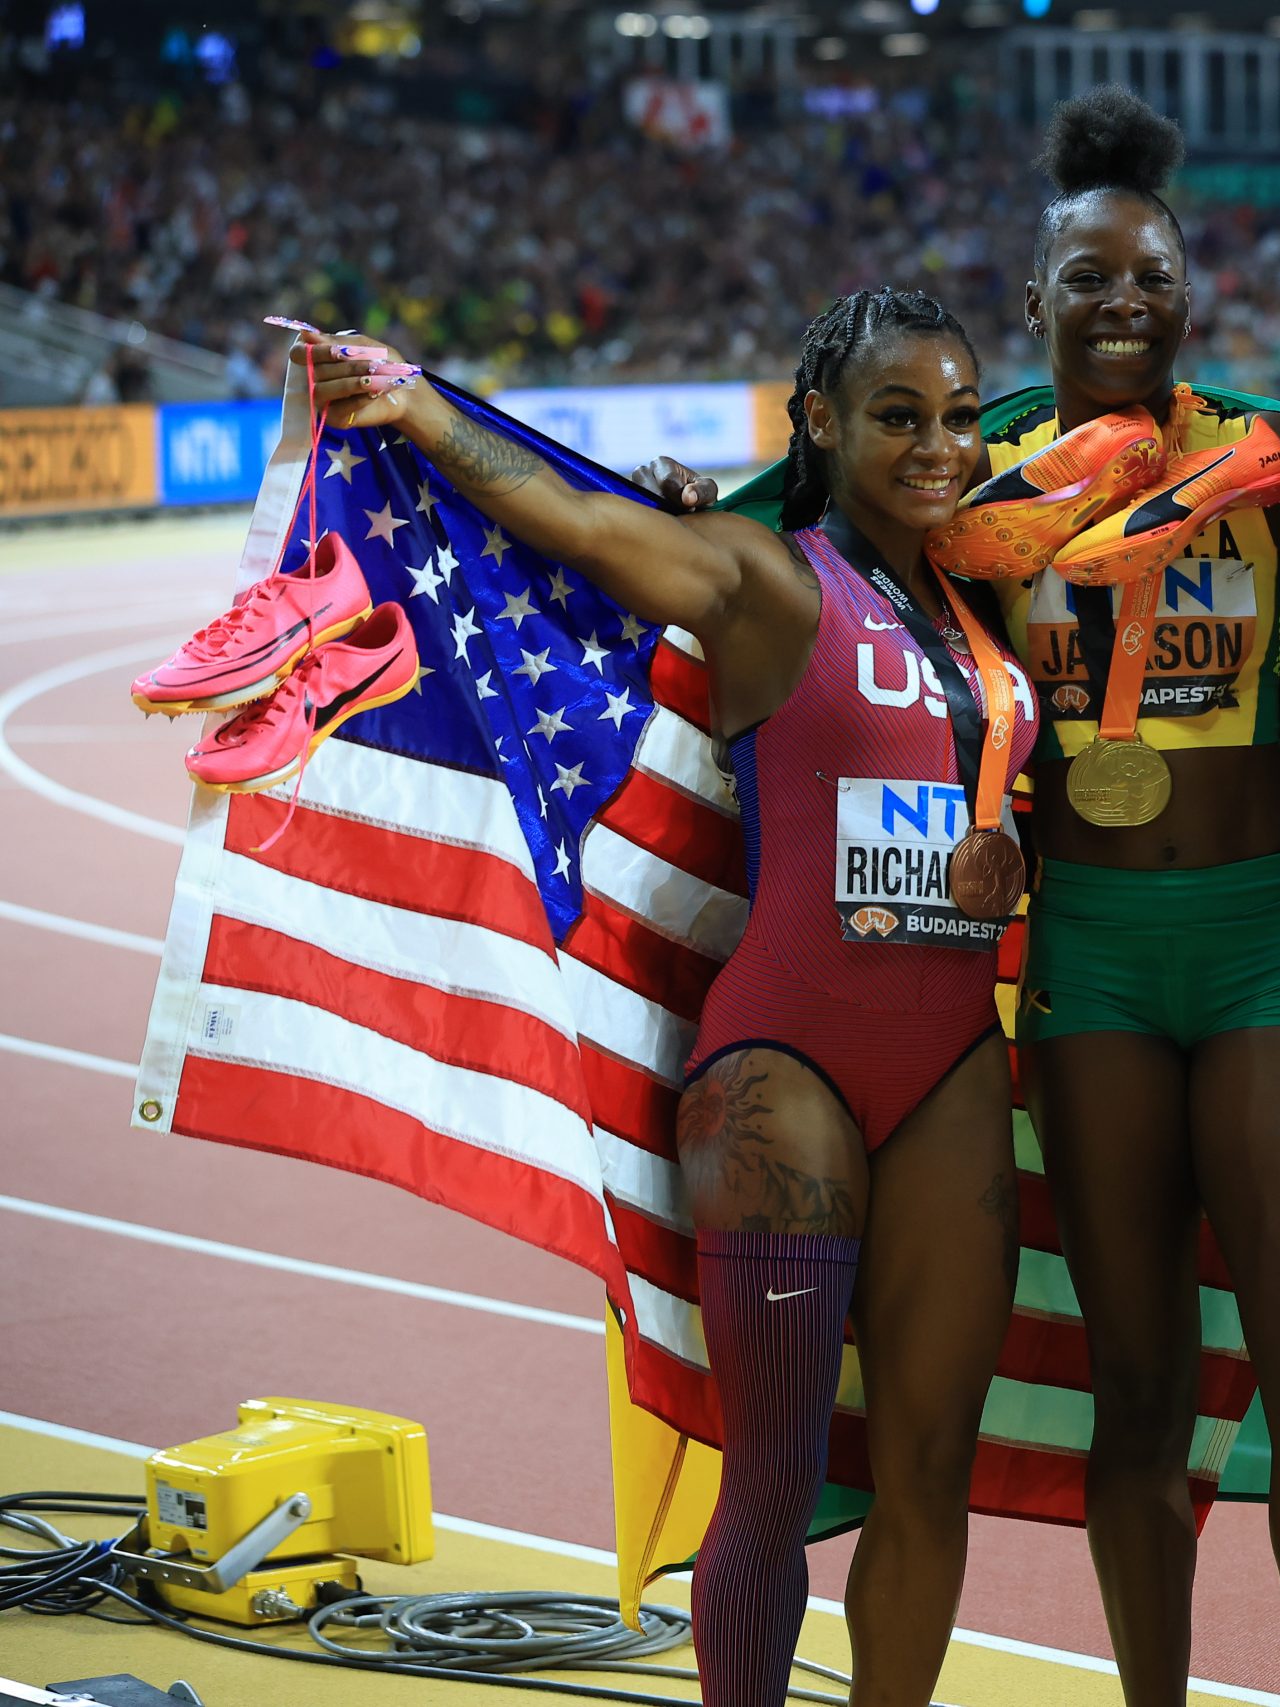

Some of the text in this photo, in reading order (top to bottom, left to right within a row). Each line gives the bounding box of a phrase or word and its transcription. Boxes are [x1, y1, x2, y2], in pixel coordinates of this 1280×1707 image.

[870, 575, 906, 610] WITNESS
[872, 567, 909, 604] WONDER
[1042, 621, 1243, 676] JASON
[882, 783, 968, 841] NT
